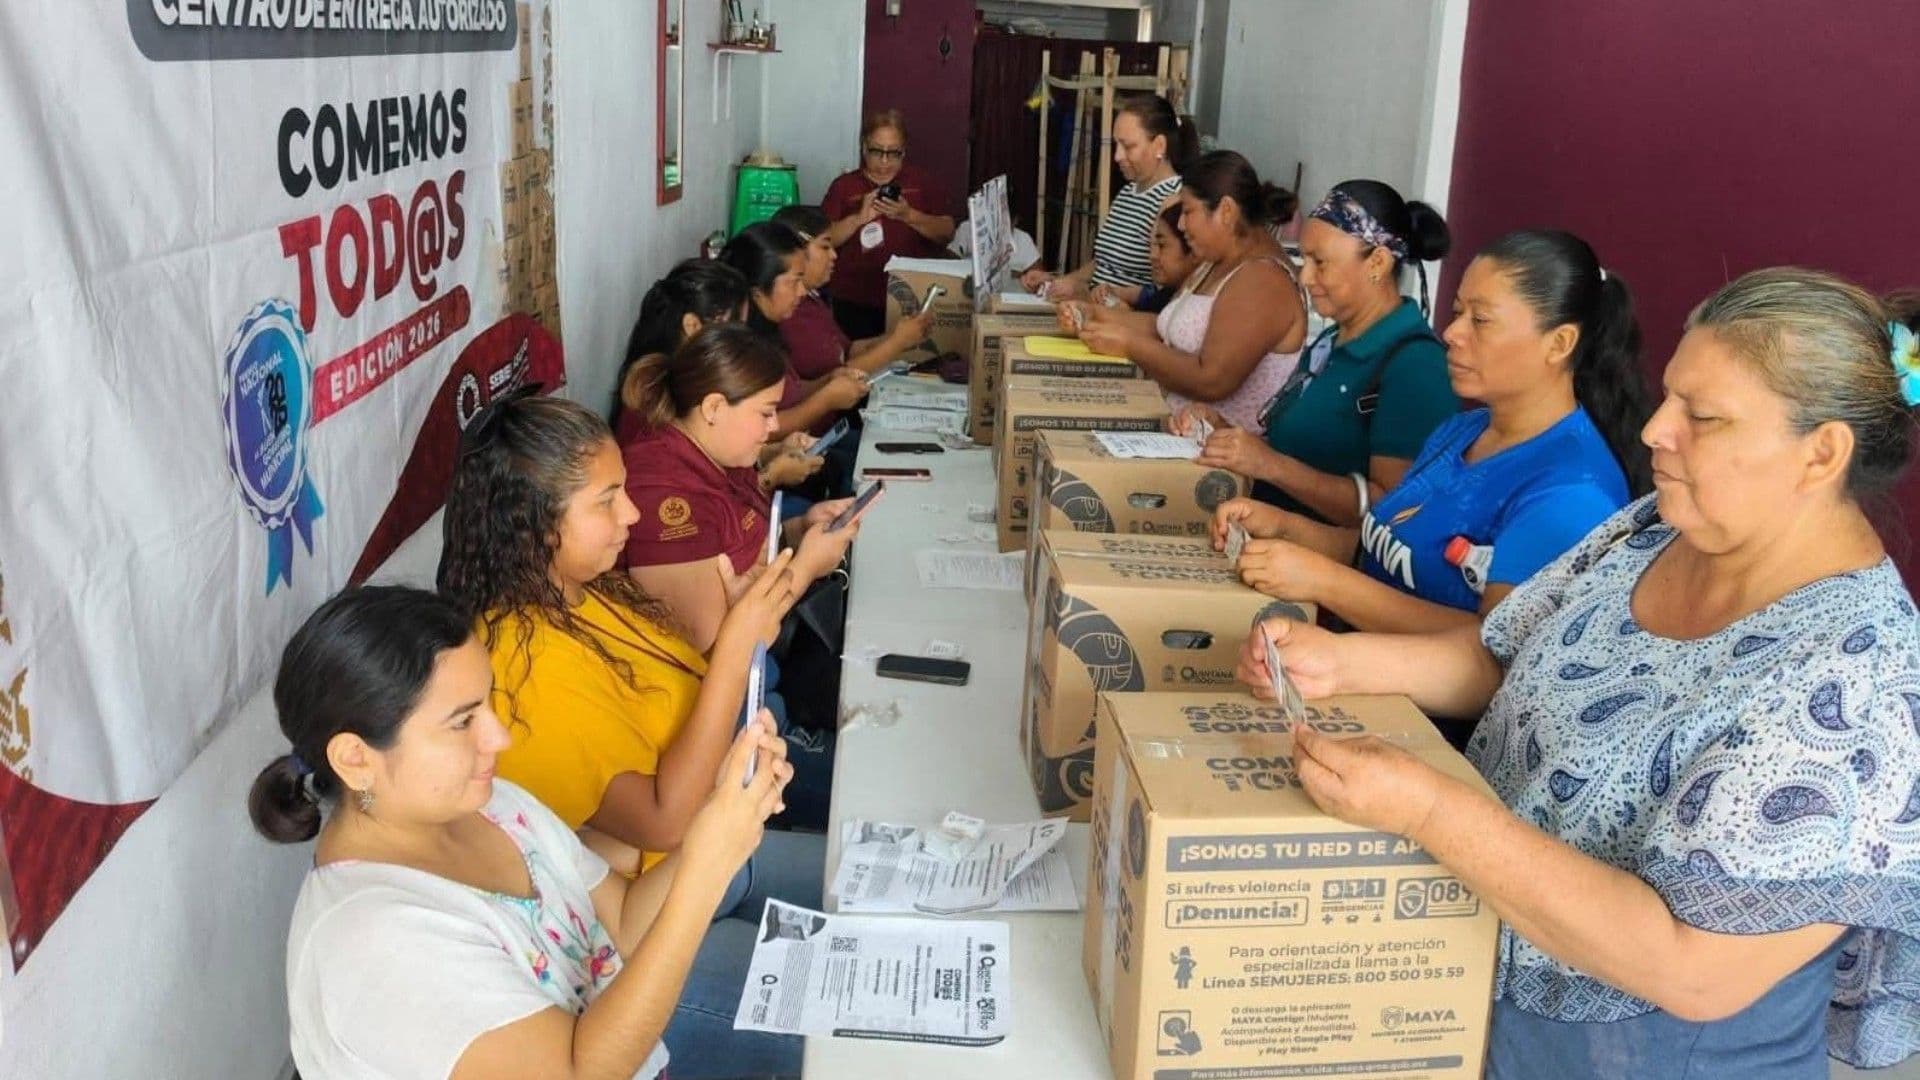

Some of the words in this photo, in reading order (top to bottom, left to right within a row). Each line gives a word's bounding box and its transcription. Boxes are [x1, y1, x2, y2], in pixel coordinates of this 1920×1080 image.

[278, 88, 467, 198] COMEMOS
[278, 169, 466, 335] TOD@S
[330, 331, 405, 402] EDICIÓN
[407, 311, 441, 354] 2026
[1062, 420, 1074, 428] TU
[1189, 721, 1366, 734] COEMOS
[1180, 842, 1268, 863] ¡SOMOS
[1272, 842, 1302, 859] TU
[1307, 841, 1352, 858] RED
[1358, 840, 1387, 856] DE
[1166, 882, 1182, 895] Si
[1185, 881, 1235, 895] sufres
[1238, 878, 1312, 894] violencia
[1326, 880, 1382, 897] 911
[1175, 901, 1299, 924] ¡Denuncia!
[1228, 945, 1265, 958] Para
[1268, 942, 1361, 957] orientación
[1364, 943, 1374, 956] y
[1377, 938, 1447, 953] atención
[1242, 956, 1351, 974] especializada
[1355, 955, 1399, 969] llama
[1402, 956, 1412, 966] a
[1416, 953, 1430, 966] la
[1202, 976, 1246, 989] Línea
[1249, 972, 1352, 988] SEMUJERES:
[1355, 971, 1387, 984] 800
[1389, 969, 1421, 981] 500
[1424, 967, 1443, 979] 95
[1446, 966, 1465, 978] 59
[1231, 1016, 1263, 1025] MAYA
[1404, 1009, 1457, 1024] MAYA
